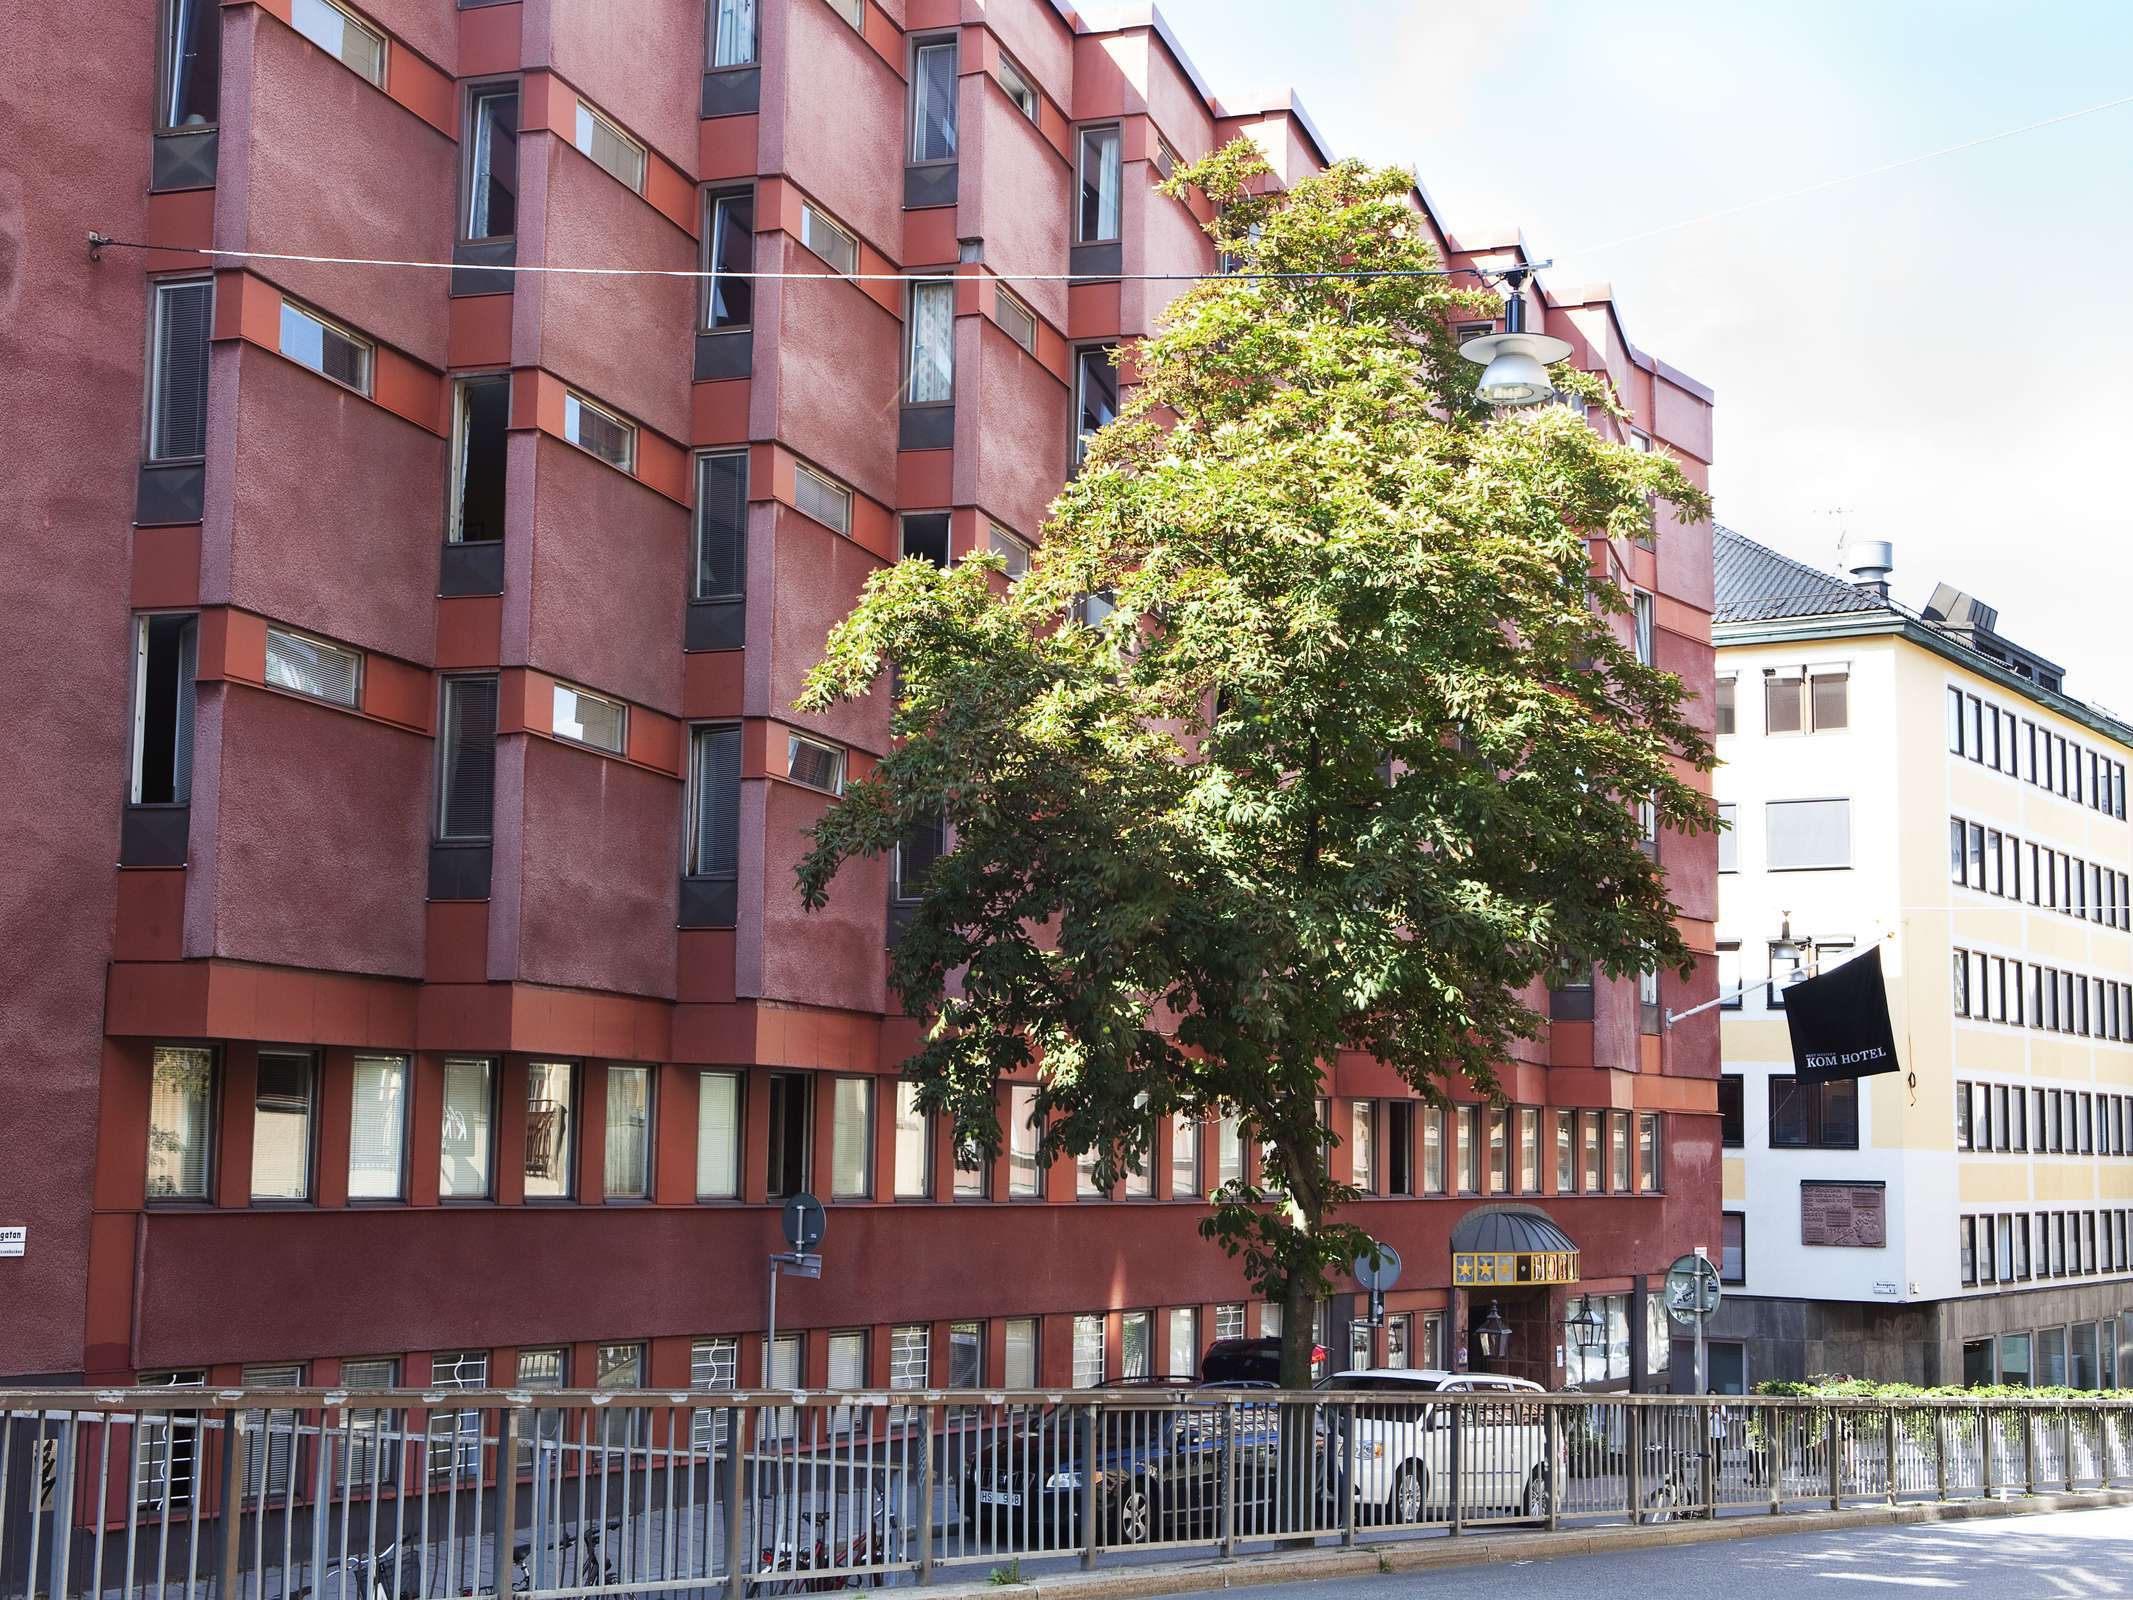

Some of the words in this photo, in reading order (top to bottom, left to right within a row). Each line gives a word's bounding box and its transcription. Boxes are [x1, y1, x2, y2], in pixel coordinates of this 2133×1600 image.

[1806, 1056, 1836, 1067] KOM
[1841, 1047, 1886, 1064] HOTEL
[1535, 1254, 1578, 1280] HOT
[1003, 1494, 1019, 1505] 98
